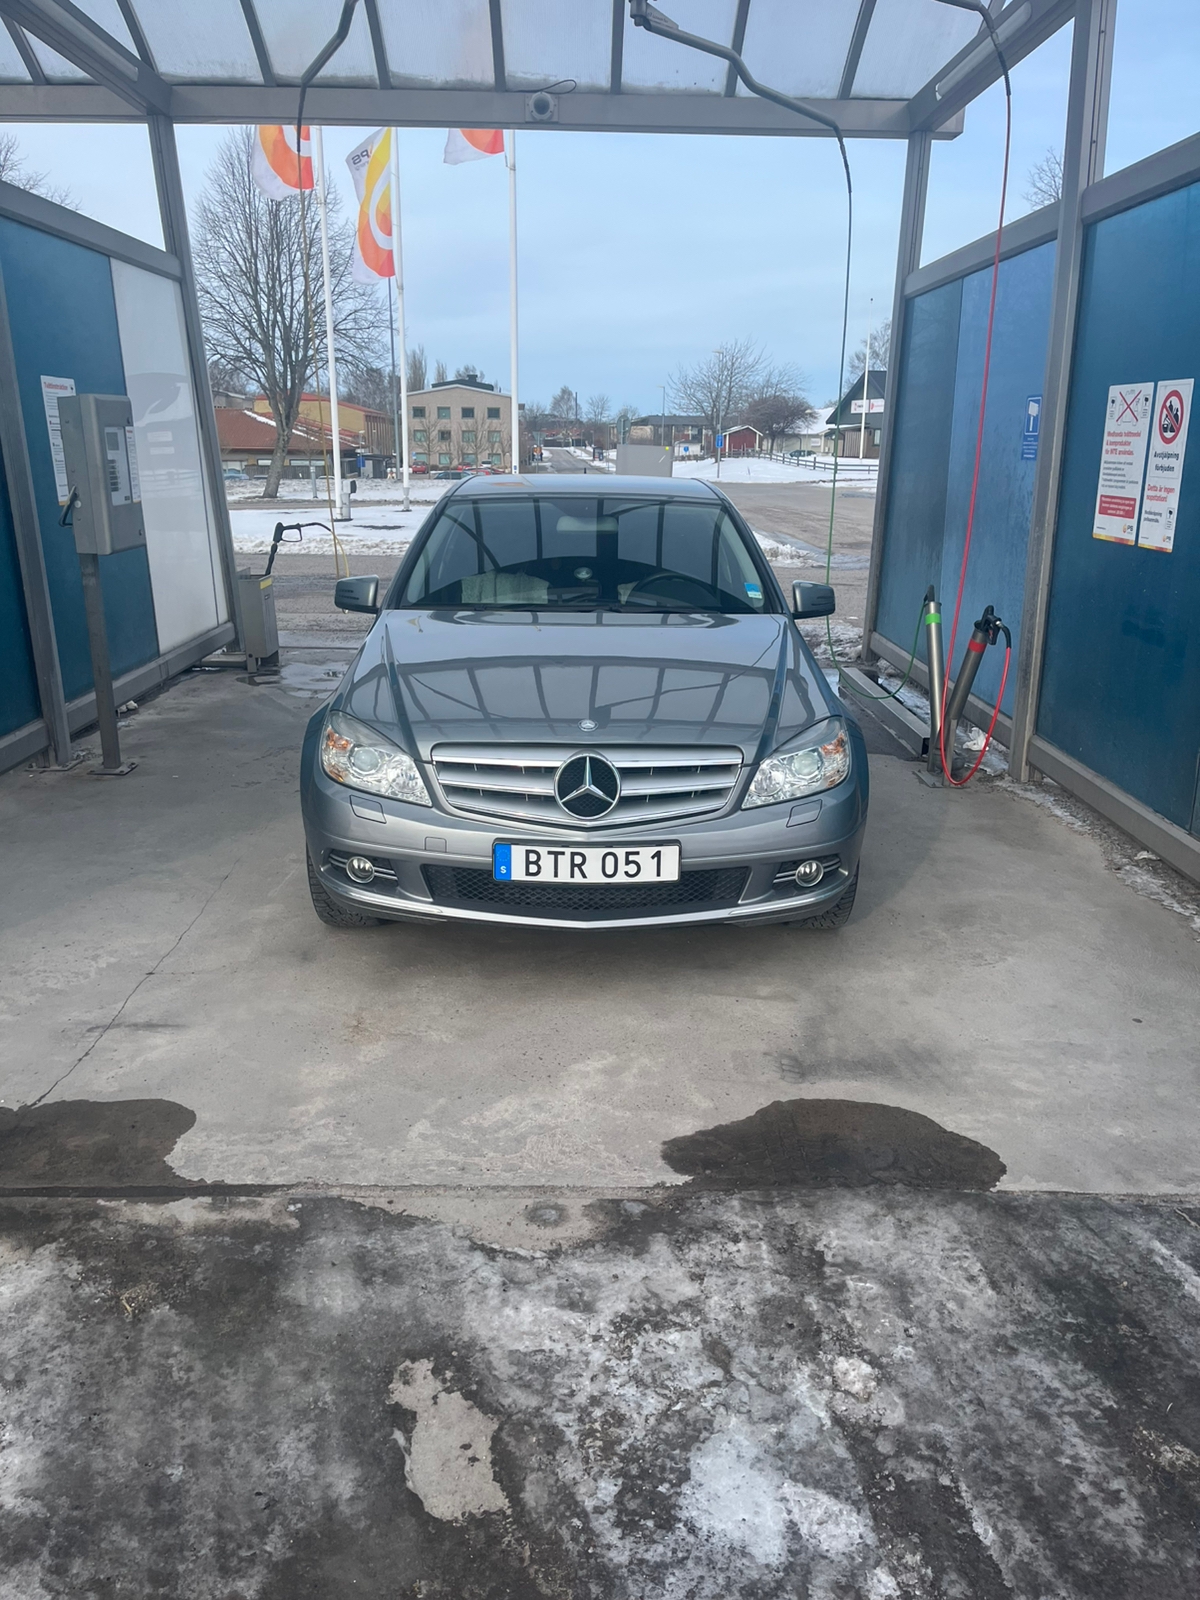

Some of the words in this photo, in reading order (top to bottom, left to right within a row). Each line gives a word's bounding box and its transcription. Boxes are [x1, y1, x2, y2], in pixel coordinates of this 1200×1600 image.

[1154, 463, 1175, 474] förbjuden
[1147, 484, 1159, 493] Detta
[525, 849, 587, 879] BTR
[601, 850, 662, 878] 051
[500, 866, 507, 874] S
